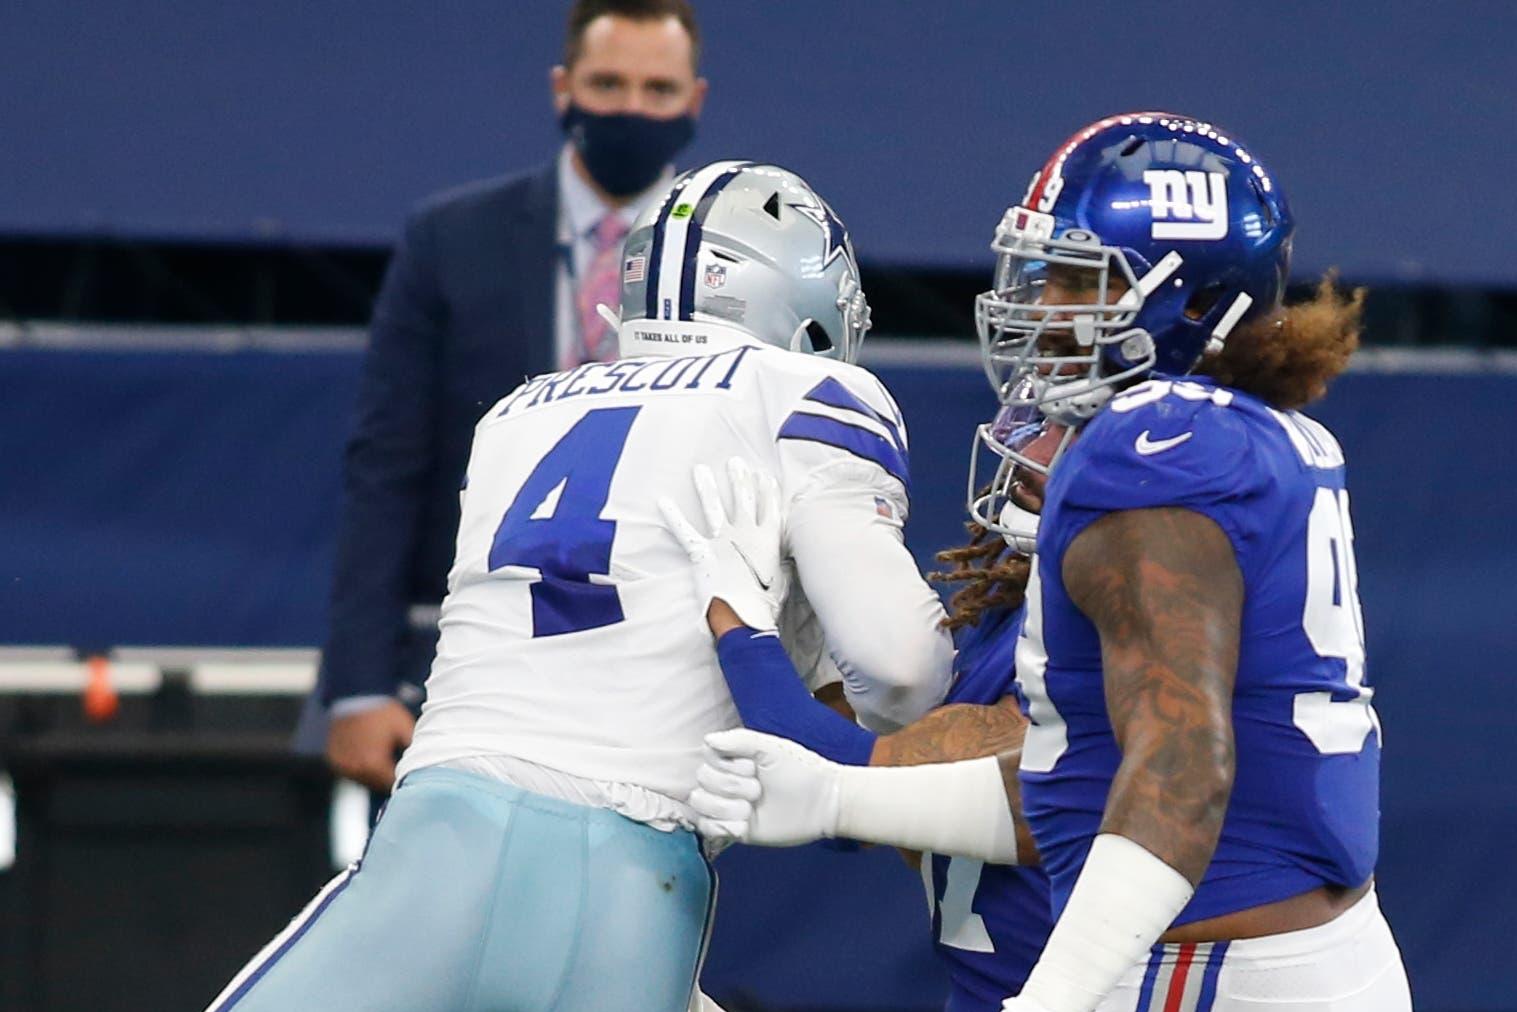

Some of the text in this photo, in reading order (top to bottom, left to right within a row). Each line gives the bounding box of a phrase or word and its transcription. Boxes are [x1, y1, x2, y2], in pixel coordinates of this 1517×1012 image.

[641, 331, 663, 342] TAKES
[664, 333, 680, 343] ALL
[682, 334, 694, 344] OF
[695, 335, 708, 344] US
[498, 345, 763, 418] PRESCOTT
[488, 405, 645, 639] 4
